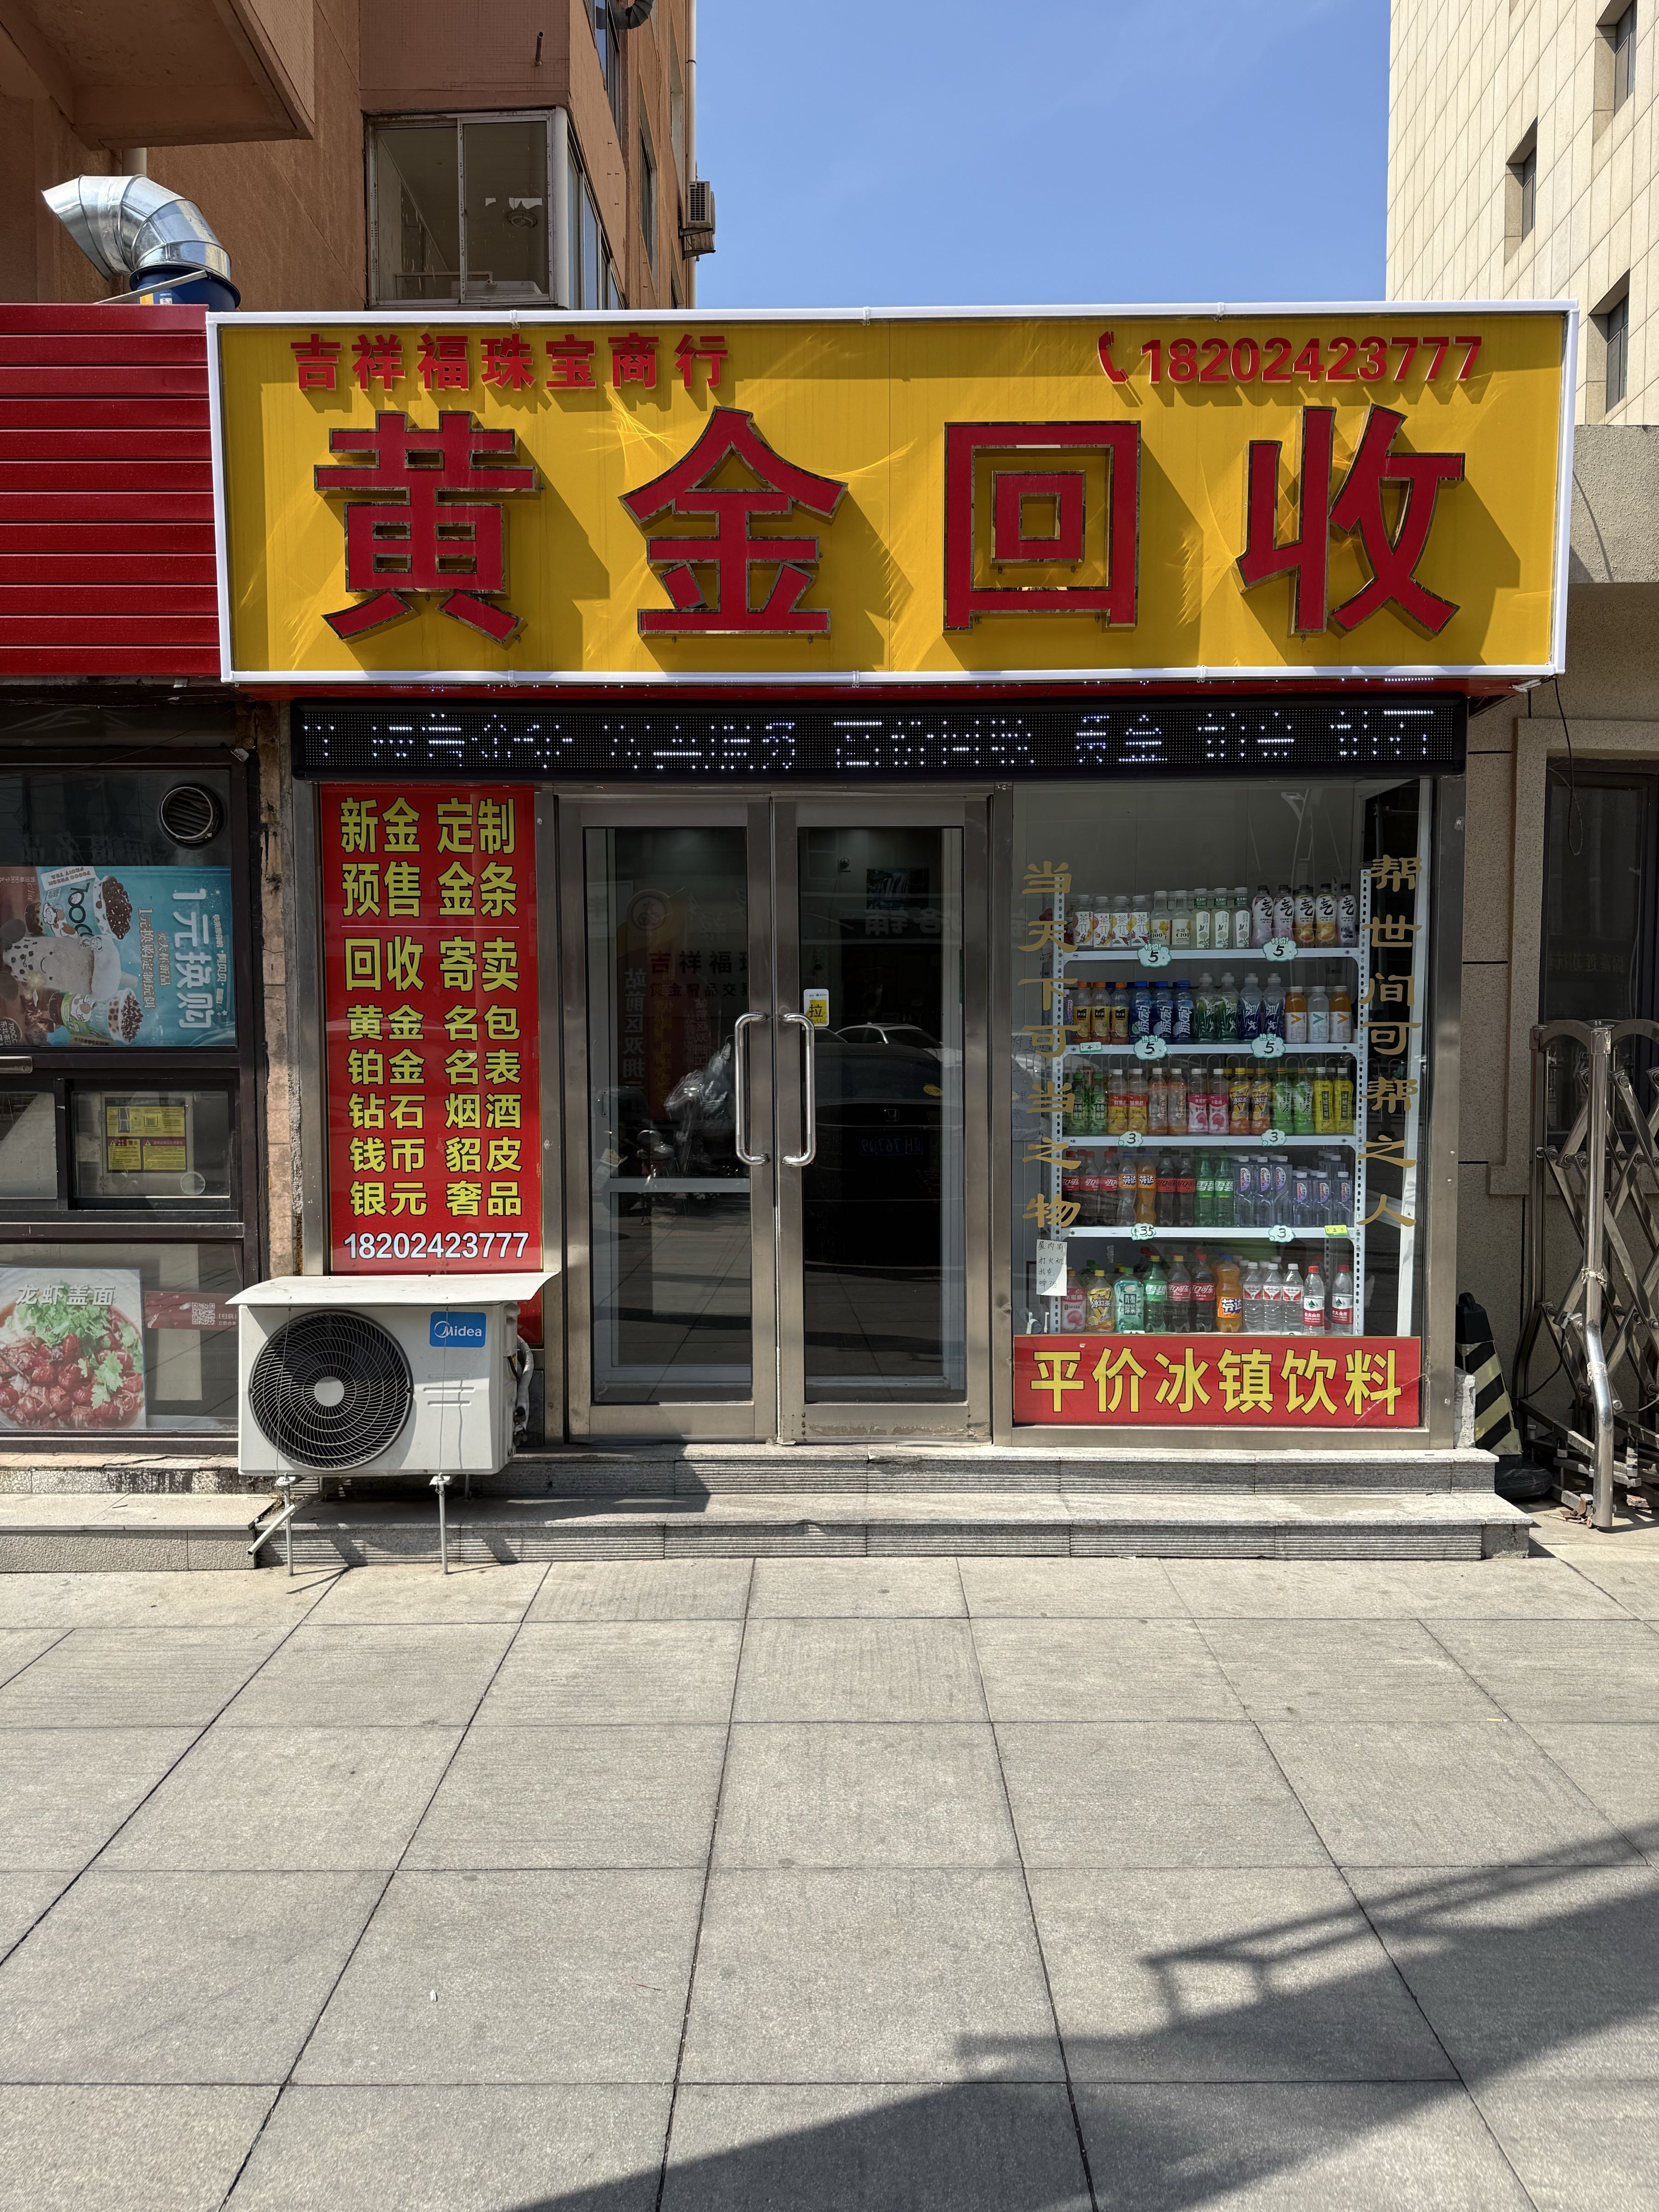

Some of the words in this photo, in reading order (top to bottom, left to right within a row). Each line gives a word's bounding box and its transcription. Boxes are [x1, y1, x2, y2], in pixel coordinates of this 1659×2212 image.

[291, 331, 729, 391] 吉祥福珠宝商行
[1141, 335, 1482, 385] 18202423777
[314, 403, 1465, 646] 黄金回收
[340, 797, 421, 853] 新金
[437, 797, 515, 854] 定制
[342, 861, 422, 917] 预售
[437, 860, 518, 917] 金条
[172, 888, 215, 1028] 1元换购
[1147, 951, 1159, 963] 5
[1273, 945, 1285, 957] 5
[344, 935, 425, 991] 回收
[439, 935, 519, 992] 寄卖
[347, 1004, 424, 1041] 黄金
[444, 1005, 521, 1041] 名包
[809, 1004, 823, 1018] 拉
[1018, 861, 1081, 1228] 当天下可当之物
[1144, 1041, 1155, 1055] 5
[1263, 1041, 1275, 1054] 5
[1356, 854, 1423, 1227] 帮世间可帮之人
[347, 1048, 425, 1085] 铂金
[444, 1049, 521, 1085] 名表
[348, 1093, 426, 1130] 钻石
[445, 1093, 522, 1130] 烟酒
[1126, 1133, 1136, 1144] 3
[1269, 1131, 1278, 1142] 3
[349, 1136, 426, 1173] 钱币
[445, 1136, 523, 1173] 貂皮
[1139, 1175, 1154, 1185] 芬达
[1215, 1181, 1234, 1191] 雪碧
[349, 1180, 427, 1217] 银元
[446, 1180, 522, 1217] 奢品
[1277, 1228, 1287, 1238] 3
[344, 1232, 529, 1259] 18202423777
[1038, 1241, 1064, 1252] 屋内有
[1038, 1257, 1064, 1265] 打火机
[15, 1284, 116, 1306] 龙虾盖面
[1145, 1284, 1166, 1295] 雪碧
[1221, 1299, 1242, 1313] 芬达
[434, 1320, 482, 1338] Midea
[1030, 1347, 1402, 1416] 平价冰镇饮料
